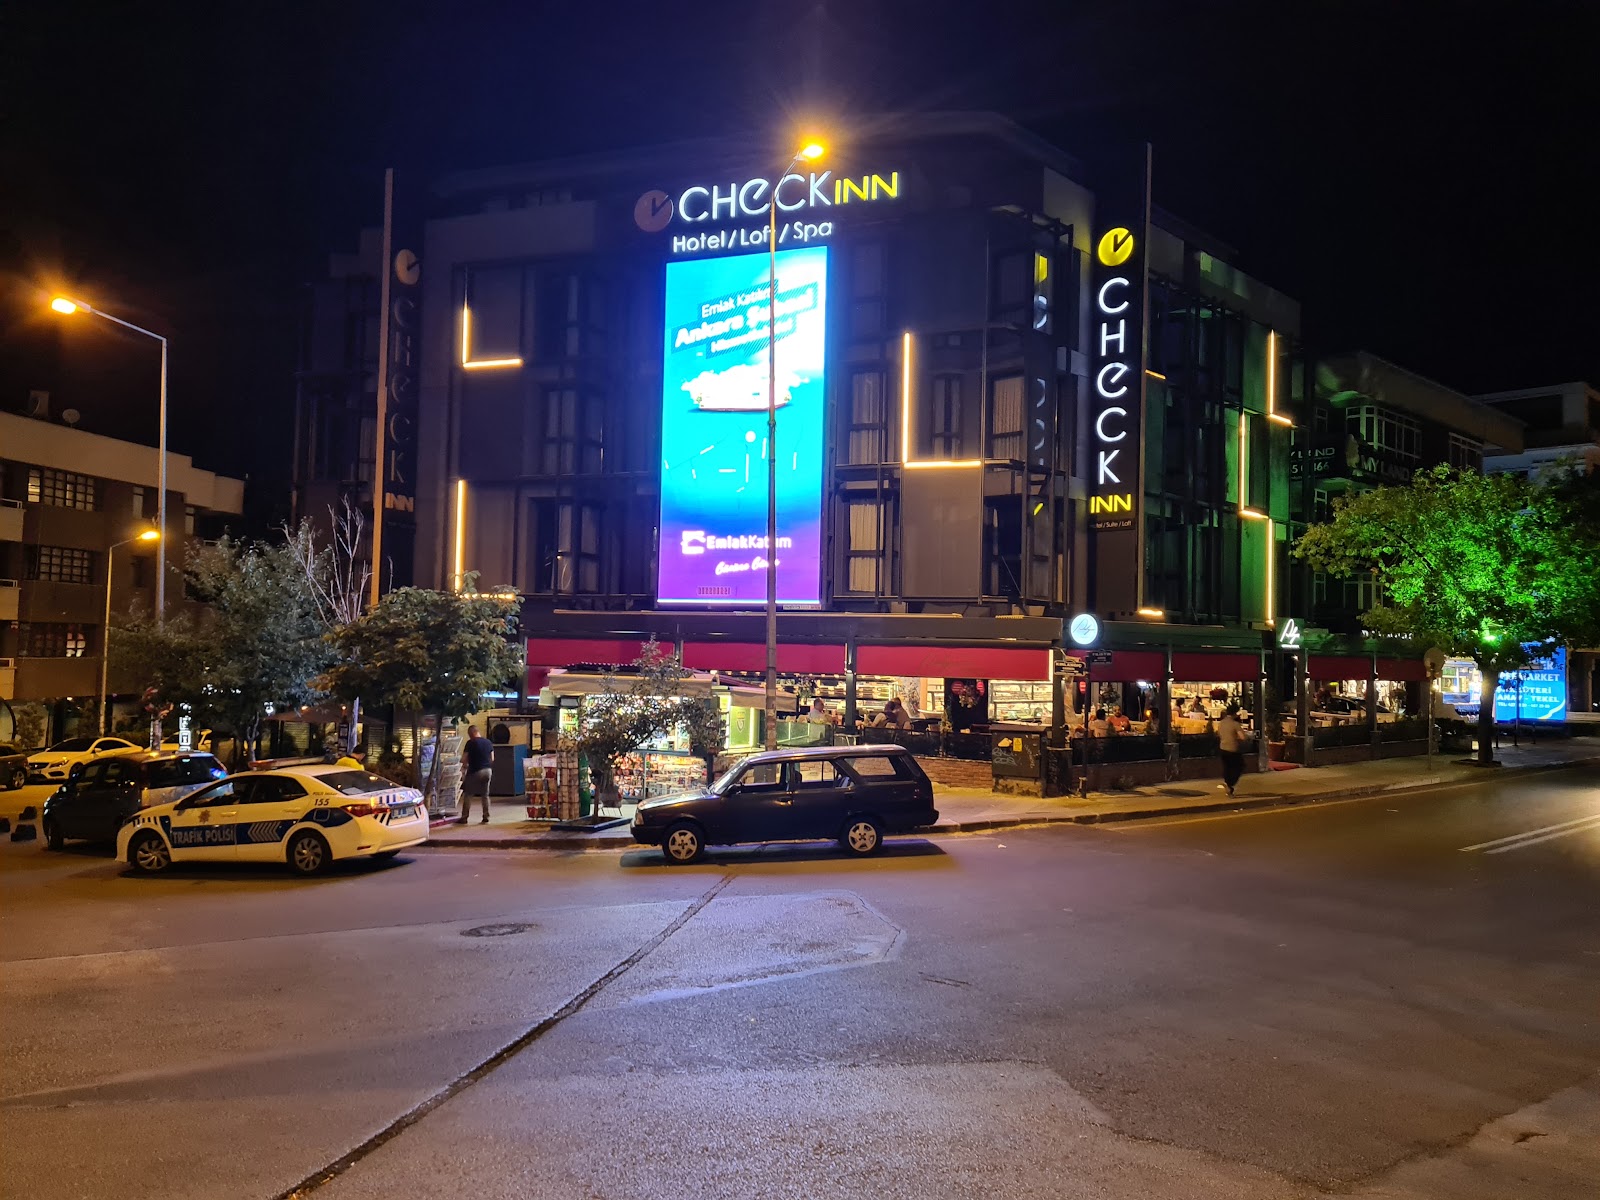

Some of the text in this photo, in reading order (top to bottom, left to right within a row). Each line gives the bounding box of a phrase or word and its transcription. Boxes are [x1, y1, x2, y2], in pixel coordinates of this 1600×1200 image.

[834, 171, 898, 205] INN
[1089, 493, 1132, 514] INN
[314, 798, 330, 806] 155
